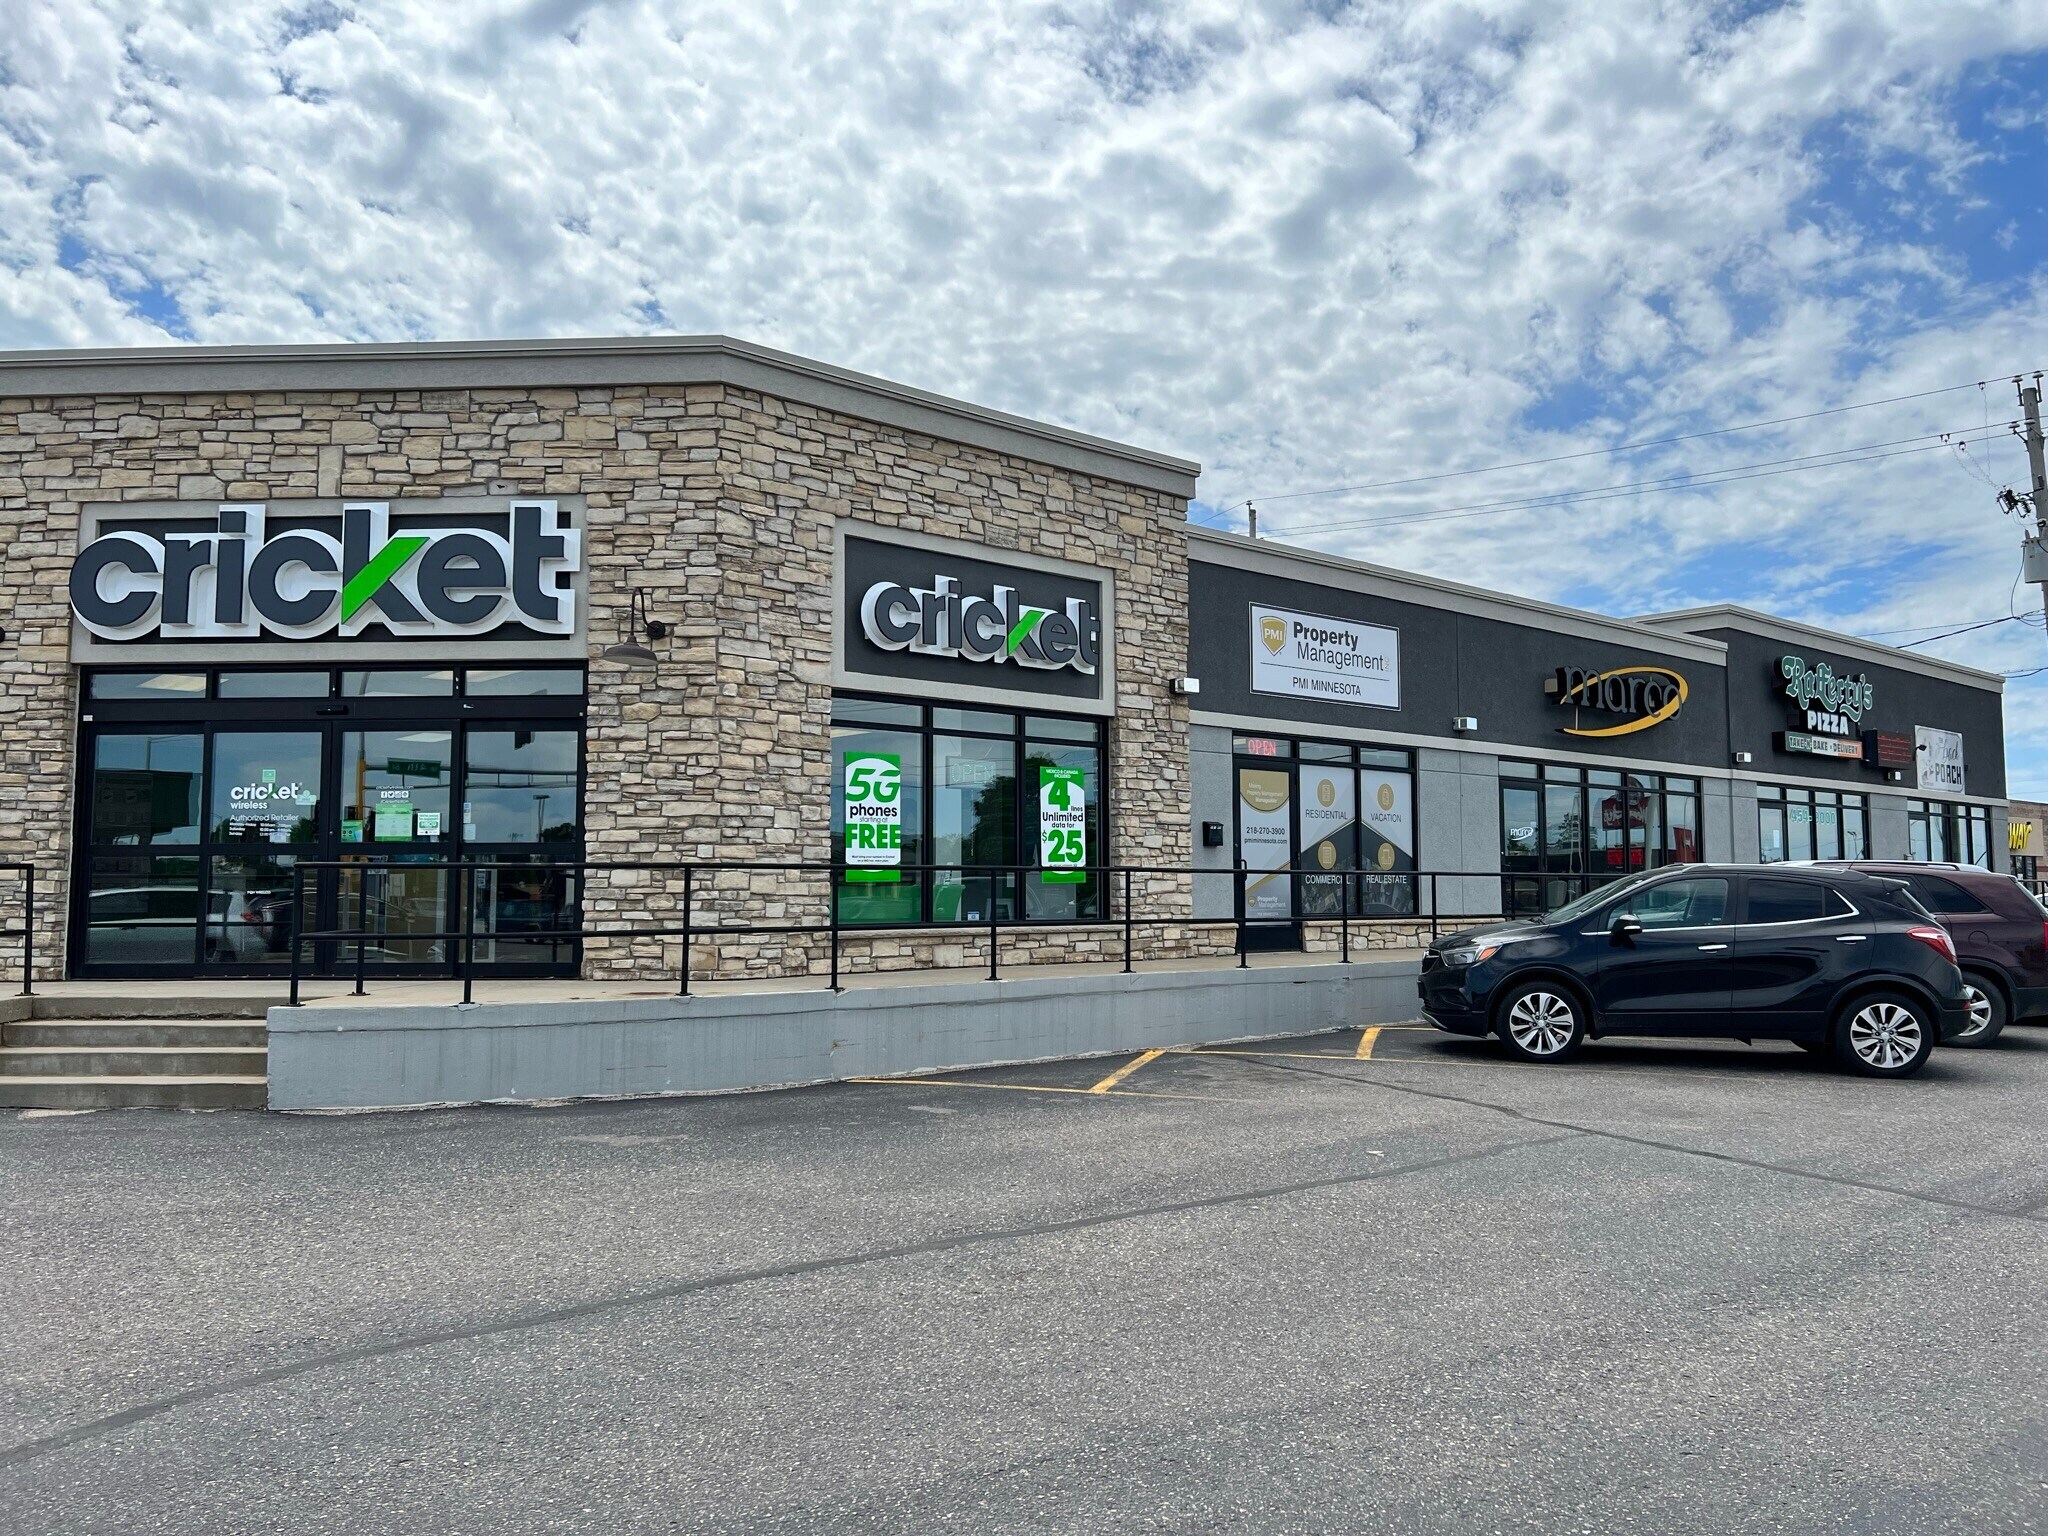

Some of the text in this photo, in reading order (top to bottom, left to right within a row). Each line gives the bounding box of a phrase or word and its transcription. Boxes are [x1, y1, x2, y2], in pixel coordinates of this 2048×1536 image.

[69, 501, 580, 640] cricket
[861, 574, 1101, 675] cricket
[1264, 628, 1283, 641] PMI
[1293, 621, 1359, 652] Property
[1297, 641, 1384, 671] Management
[1292, 676, 1361, 696] PMI MINNESOTA
[1781, 655, 1873, 723] Rafferty's
[1807, 709, 1849, 735] PIZZA
[1248, 738, 1277, 757] OPEN
[1832, 742, 1858, 755] DELIVERY
[1935, 762, 1962, 785] PORCH
[230, 782, 300, 800] cricket
[845, 767, 901, 803] 5G
[1048, 779, 1071, 812] 4
[230, 801, 268, 810] wireless
[849, 803, 898, 819] phones
[1305, 809, 1348, 820] RESIDENTIAL
[859, 816, 881, 824] starting
[1042, 811, 1084, 823] Unlimited
[1371, 813, 1402, 823] VACATION
[845, 823, 901, 849] FREE
[1246, 826, 1286, 836] 218-270-3900
[1305, 875, 1351, 885] COMMERCIL
[1366, 875, 1407, 883] REAL ESTATE
